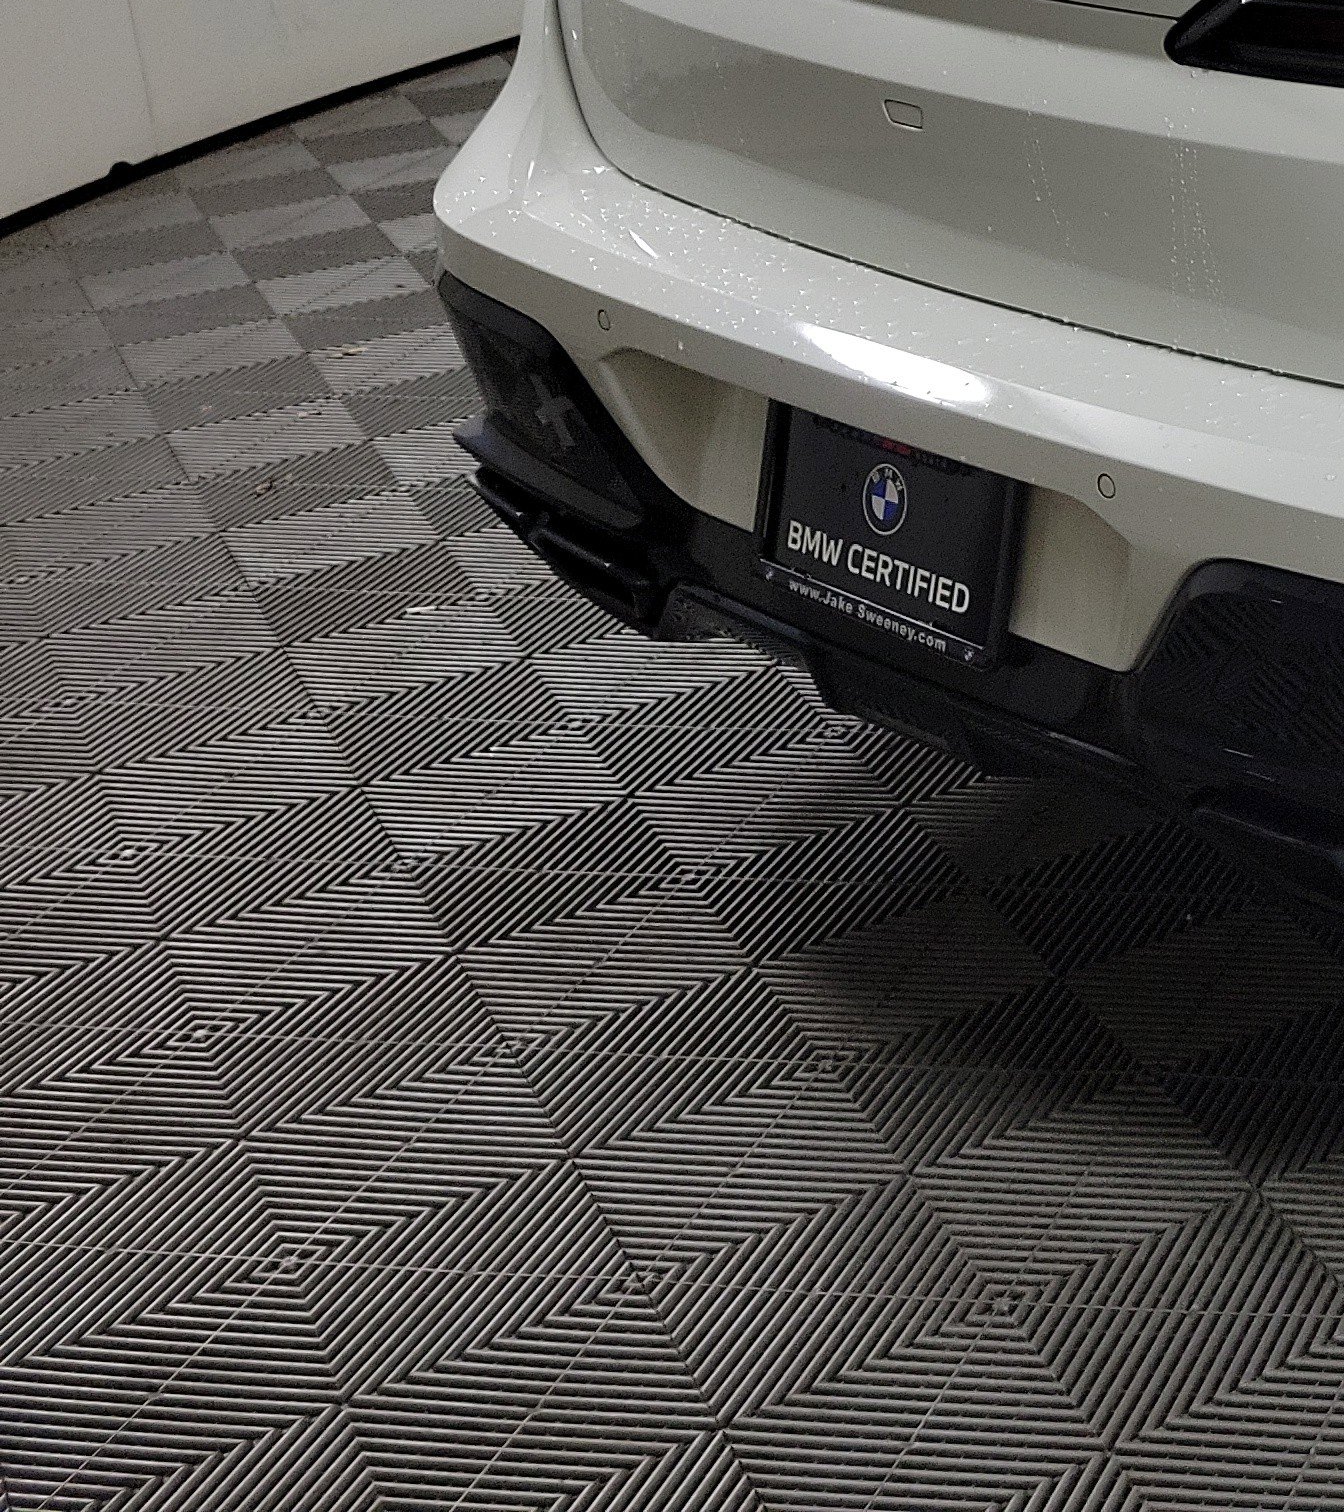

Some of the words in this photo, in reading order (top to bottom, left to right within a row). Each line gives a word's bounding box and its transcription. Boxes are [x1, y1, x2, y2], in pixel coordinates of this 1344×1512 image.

[787, 520, 843, 567] BMW
[847, 543, 970, 614] CERTIFIED
[789, 580, 853, 614] www.Jake
[858, 603, 947, 653] Sweeney.com
